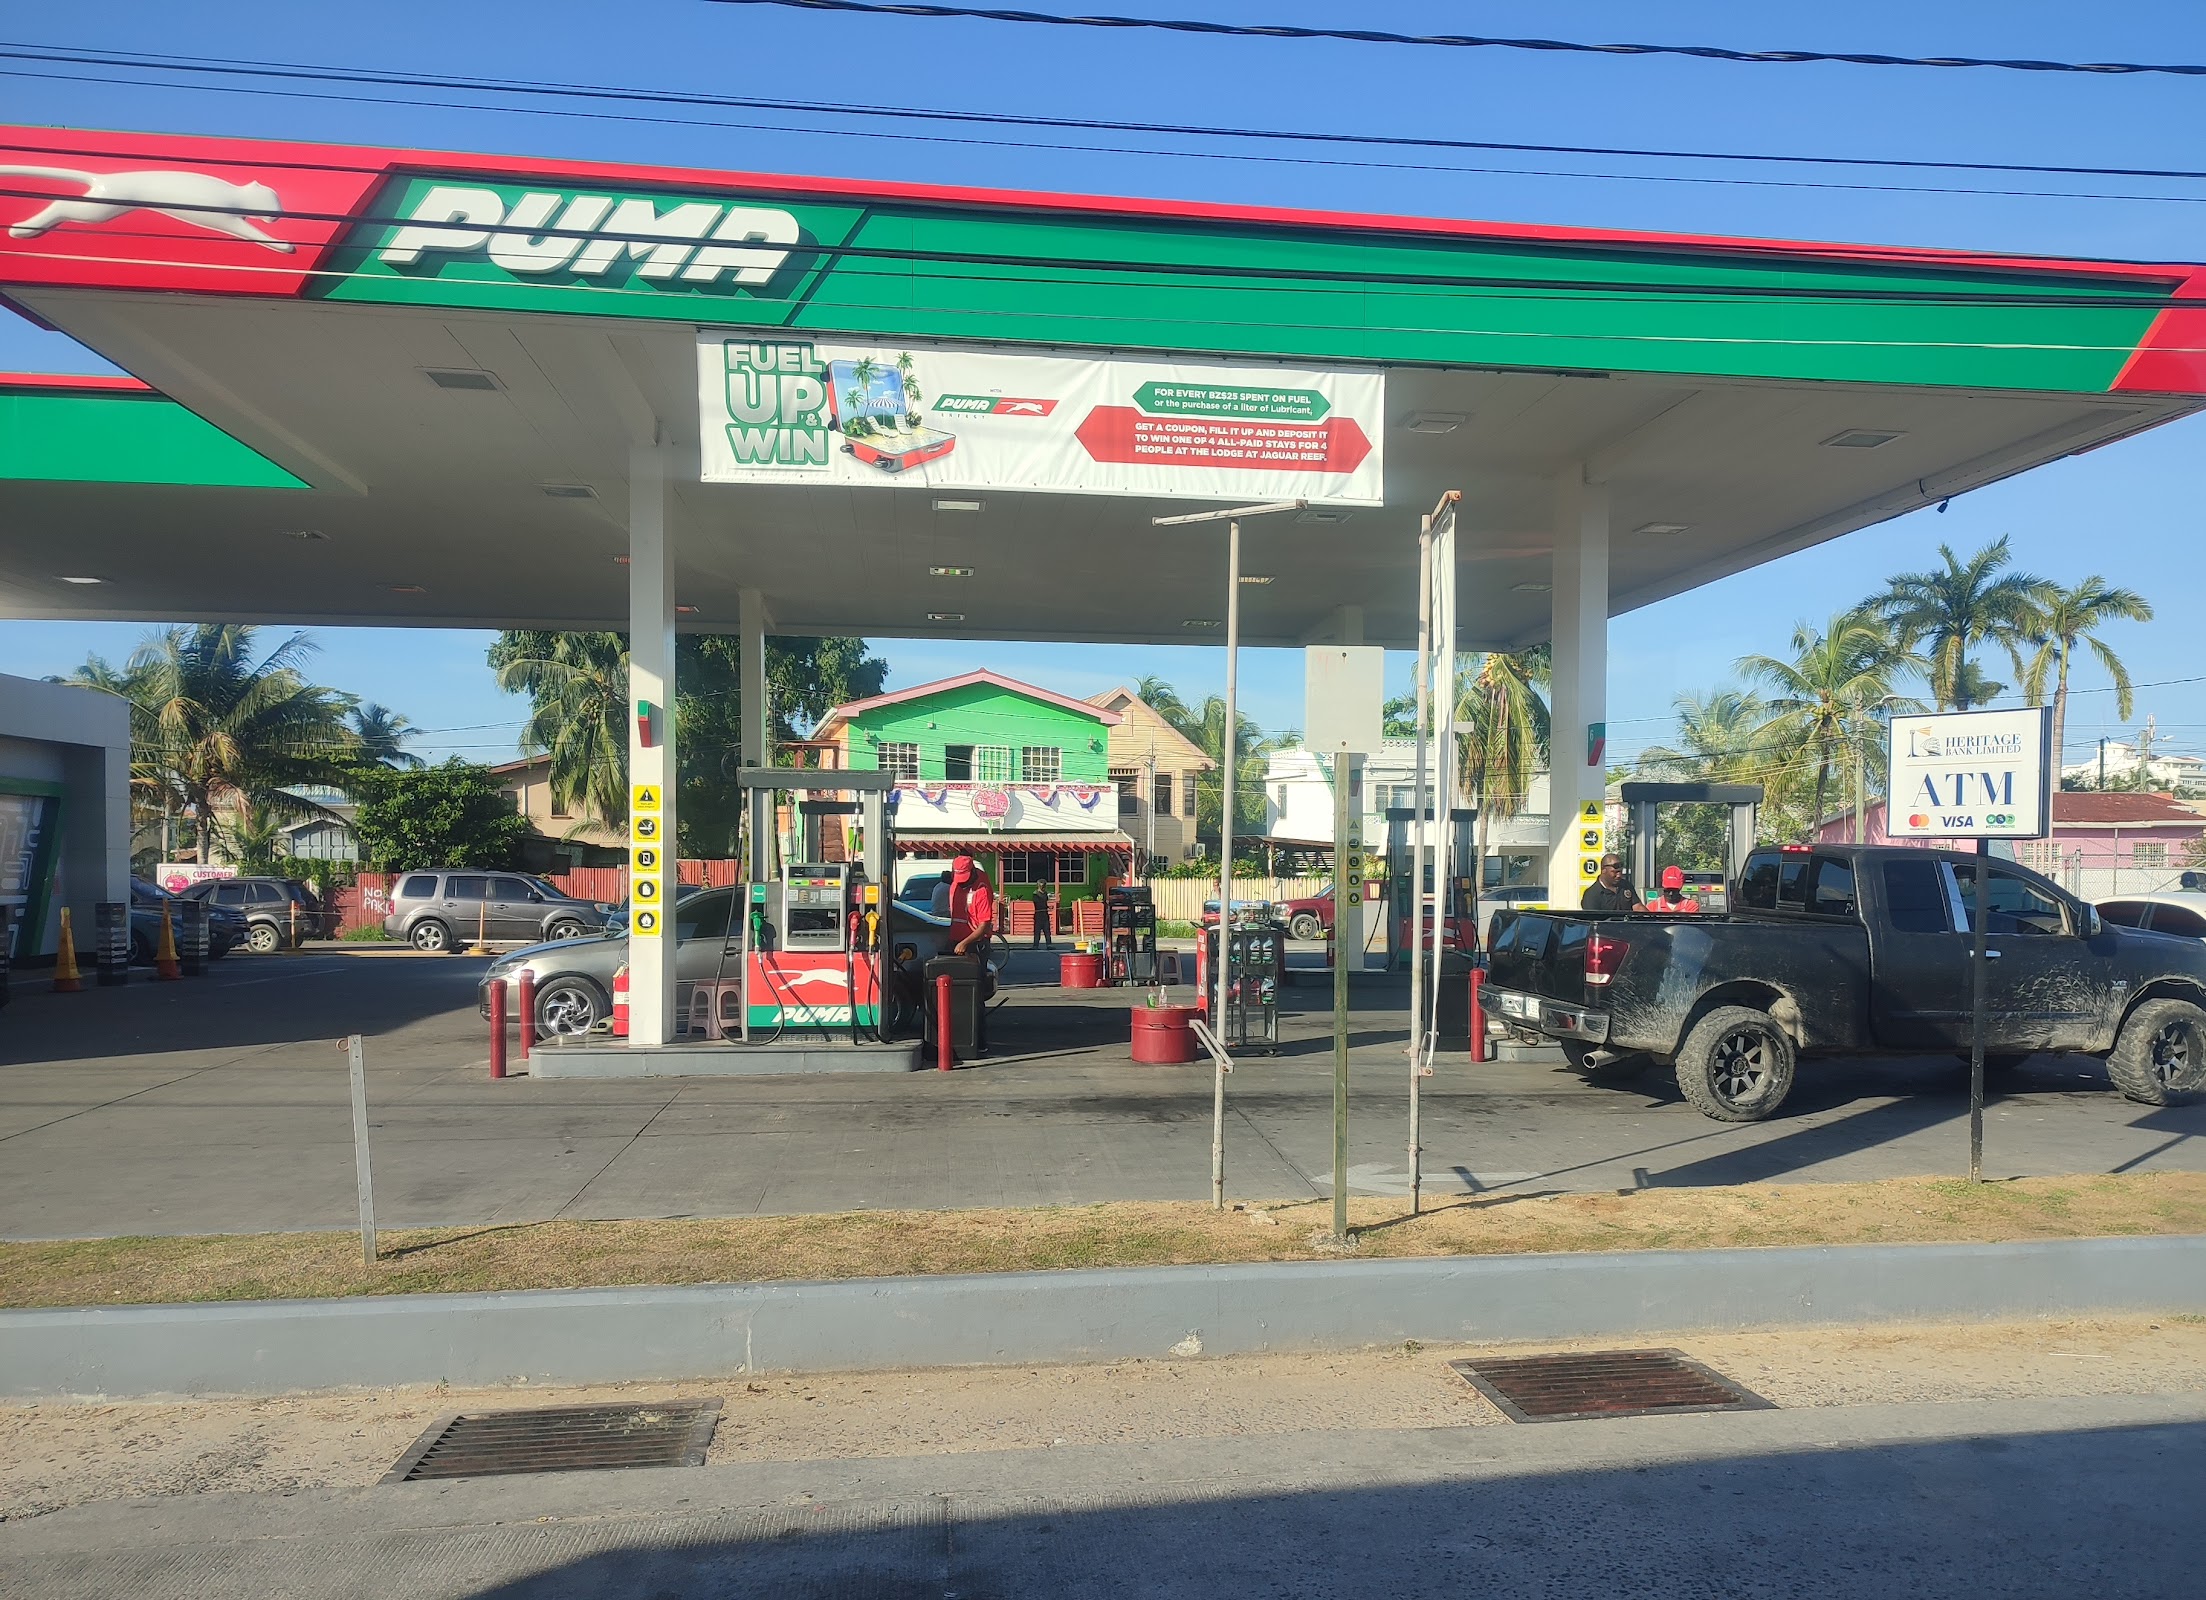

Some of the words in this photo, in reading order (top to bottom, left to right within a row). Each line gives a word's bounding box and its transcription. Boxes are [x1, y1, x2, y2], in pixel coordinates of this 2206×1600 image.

[378, 186, 800, 288] PUMA
[726, 341, 823, 373] FUEL
[728, 373, 824, 424] UP
[805, 413, 818, 427] &
[1154, 388, 1174, 397] FOR
[1176, 389, 1207, 399] EVERY
[1209, 391, 1238, 401] BZ$25
[1240, 392, 1270, 402] SPENT
[1271, 394, 1287, 403] ON
[1288, 395, 1311, 404] FUEL
[940, 398, 990, 411] PUMA
[1166, 399, 1180, 407] the
[1182, 401, 1220, 410] purchase
[1222, 402, 1231, 411] of
[1241, 402, 1258, 412] liter
[1260, 404, 1269, 412] of
[1135, 423, 1154, 431] GET
[1156, 424, 1163, 432] A
[1165, 424, 1207, 435] COUPON,
[1209, 426, 1228, 435] FILL
[1230, 427, 1239, 435] IT
[1241, 427, 1254, 436] UP
[1255, 428, 1276, 437] AND
[1277, 429, 1317, 438] DEPOSIT
[1319, 431, 1328, 439] IT
[728, 427, 826, 462] WIN
[1135, 434, 1148, 442] TO
[1150, 434, 1170, 443] WIN
[1172, 435, 1192, 444] ONE
[1193, 436, 1207, 444] OF
[1208, 437, 1215, 445] 4
[1217, 438, 1263, 447] ALL-PAID
[1265, 440, 1296, 449] STAYS
[1298, 442, 1318, 450] FOR
[1320, 442, 1327, 450] 4
[1135, 445, 1173, 454] PEOPLE
[1175, 446, 1189, 455] AT
[1190, 447, 1209, 456] THE
[1211, 448, 1243, 458] LODGE
[1245, 450, 1258, 458] AT
[1260, 451, 1298, 460] JAGUAR
[1300, 452, 1328, 462] REEF.
[1945, 733, 2021, 748] HERITAGE
[1945, 748, 1973, 757] BANK
[1976, 745, 2021, 755] LIMITED
[1908, 771, 2016, 808] ATM
[1940, 815, 1974, 828] VISA
[771, 1006, 852, 1023] PUMA
